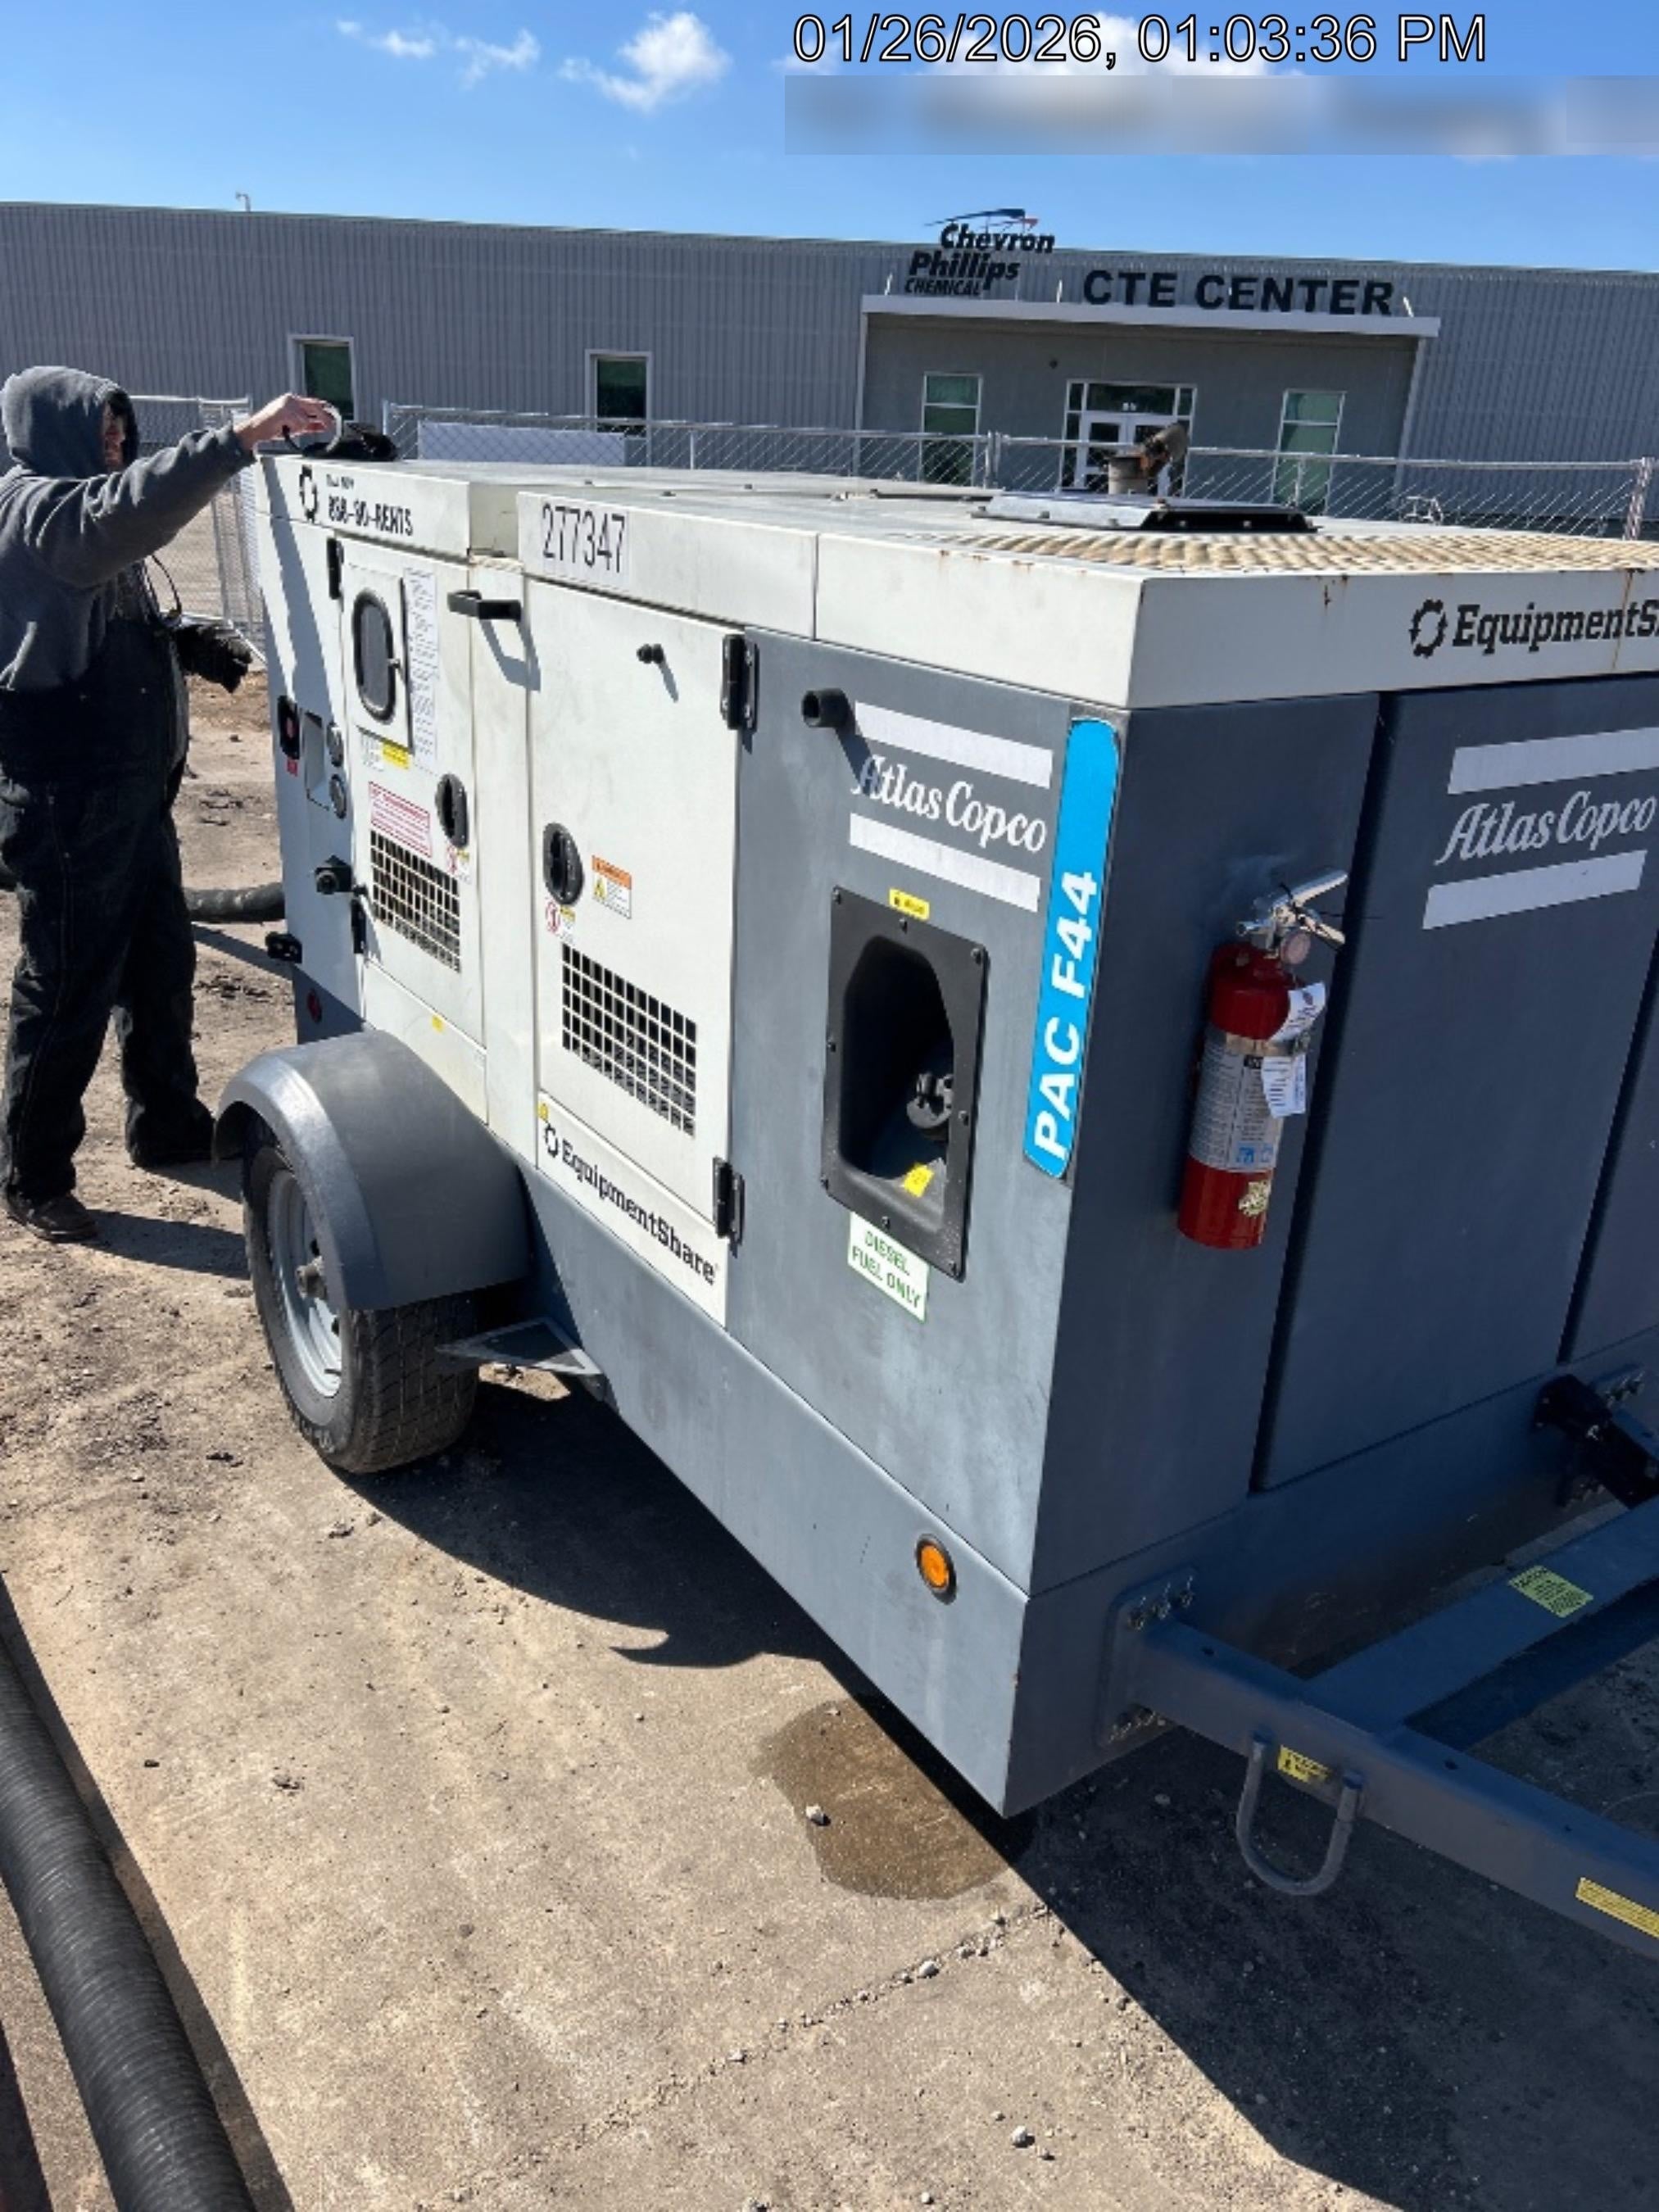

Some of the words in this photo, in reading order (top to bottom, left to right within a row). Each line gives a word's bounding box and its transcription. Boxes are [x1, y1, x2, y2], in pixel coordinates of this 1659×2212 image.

[941, 223, 1055, 253] Chevron
[904, 278, 981, 296] CHEMICAL
[909, 250, 1021, 290] Phillips
[1083, 270, 1178, 307] CTE
[1194, 274, 1394, 315] CENTER
[542, 502, 625, 573] 277347
[1453, 599, 1659, 655] EquipmentS
[850, 754, 943, 820] Atlas
[945, 780, 1046, 852] Copco
[1434, 800, 1554, 866] Atlas
[1557, 790, 1657, 851] Copco
[1051, 871, 1098, 1000] F44
[1034, 1017, 1081, 1160] PAC
[562, 1139, 715, 1286] EquipmentShare
[852, 1245, 883, 1281] FUEL
[886, 1272, 922, 1308] ONLY
[865, 1231, 911, 1276] DIESEL
